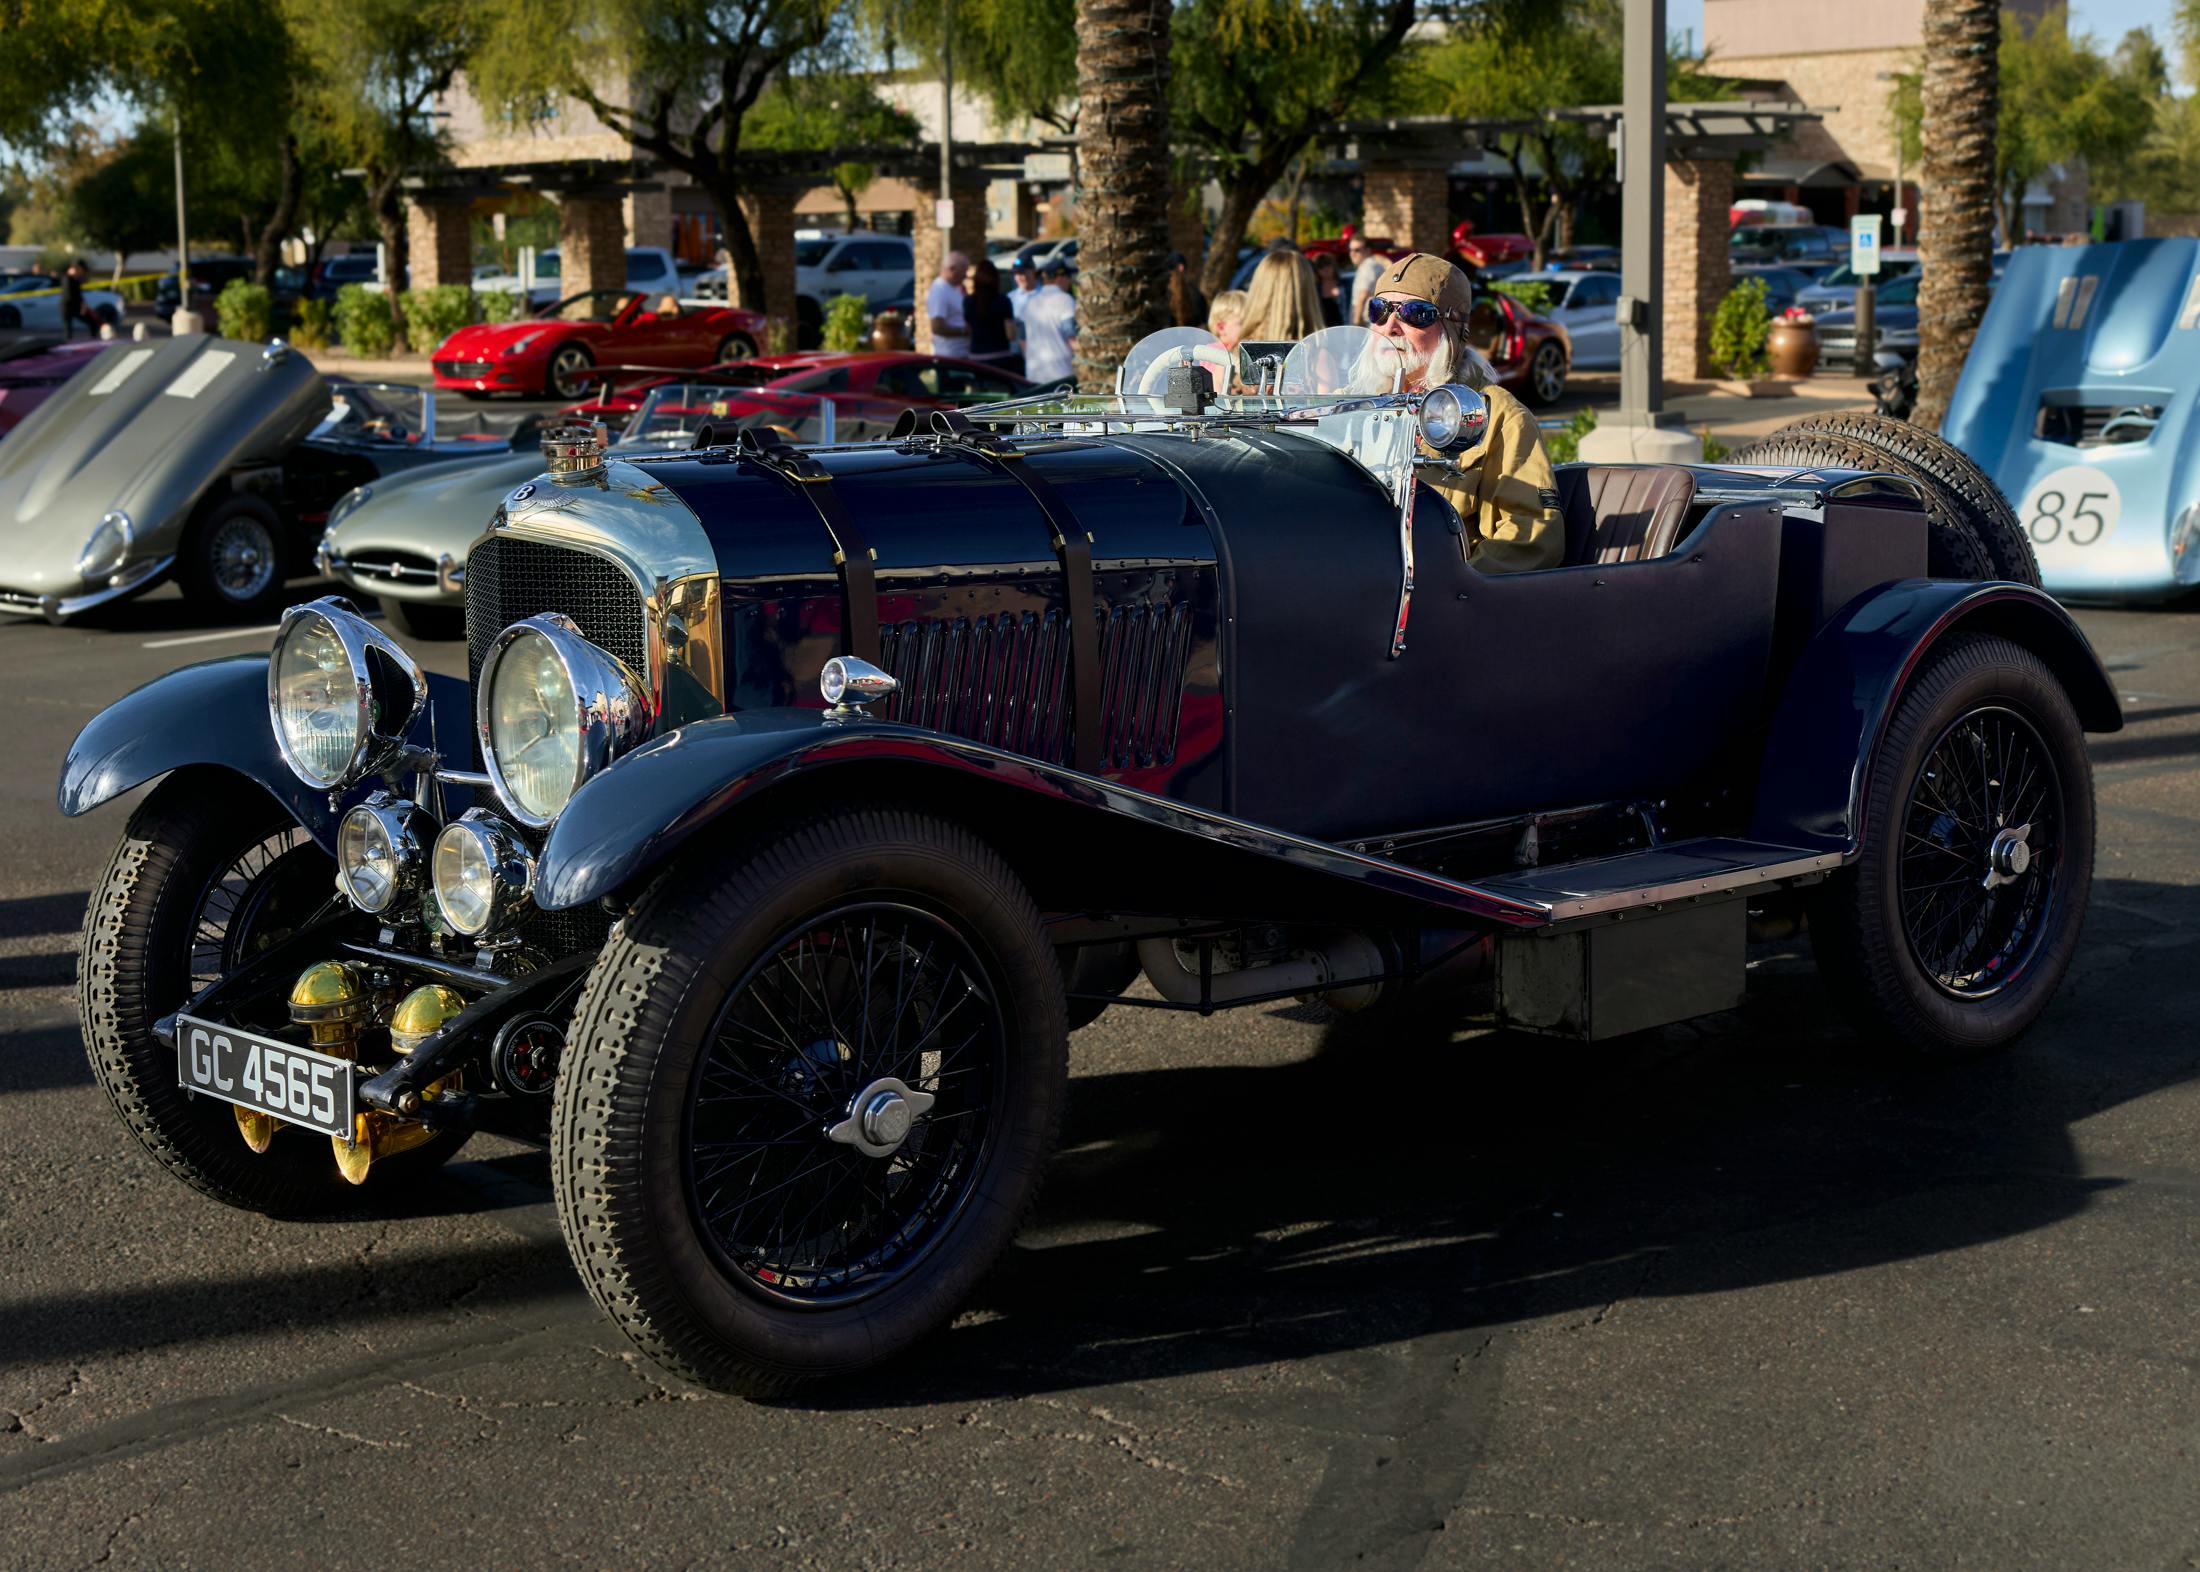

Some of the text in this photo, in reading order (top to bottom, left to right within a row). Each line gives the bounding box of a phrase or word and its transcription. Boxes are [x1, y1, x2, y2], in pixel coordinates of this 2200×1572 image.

[514, 485, 533, 500] B
[2029, 490, 2108, 547] 85
[191, 1029, 335, 1125] GC 4565
